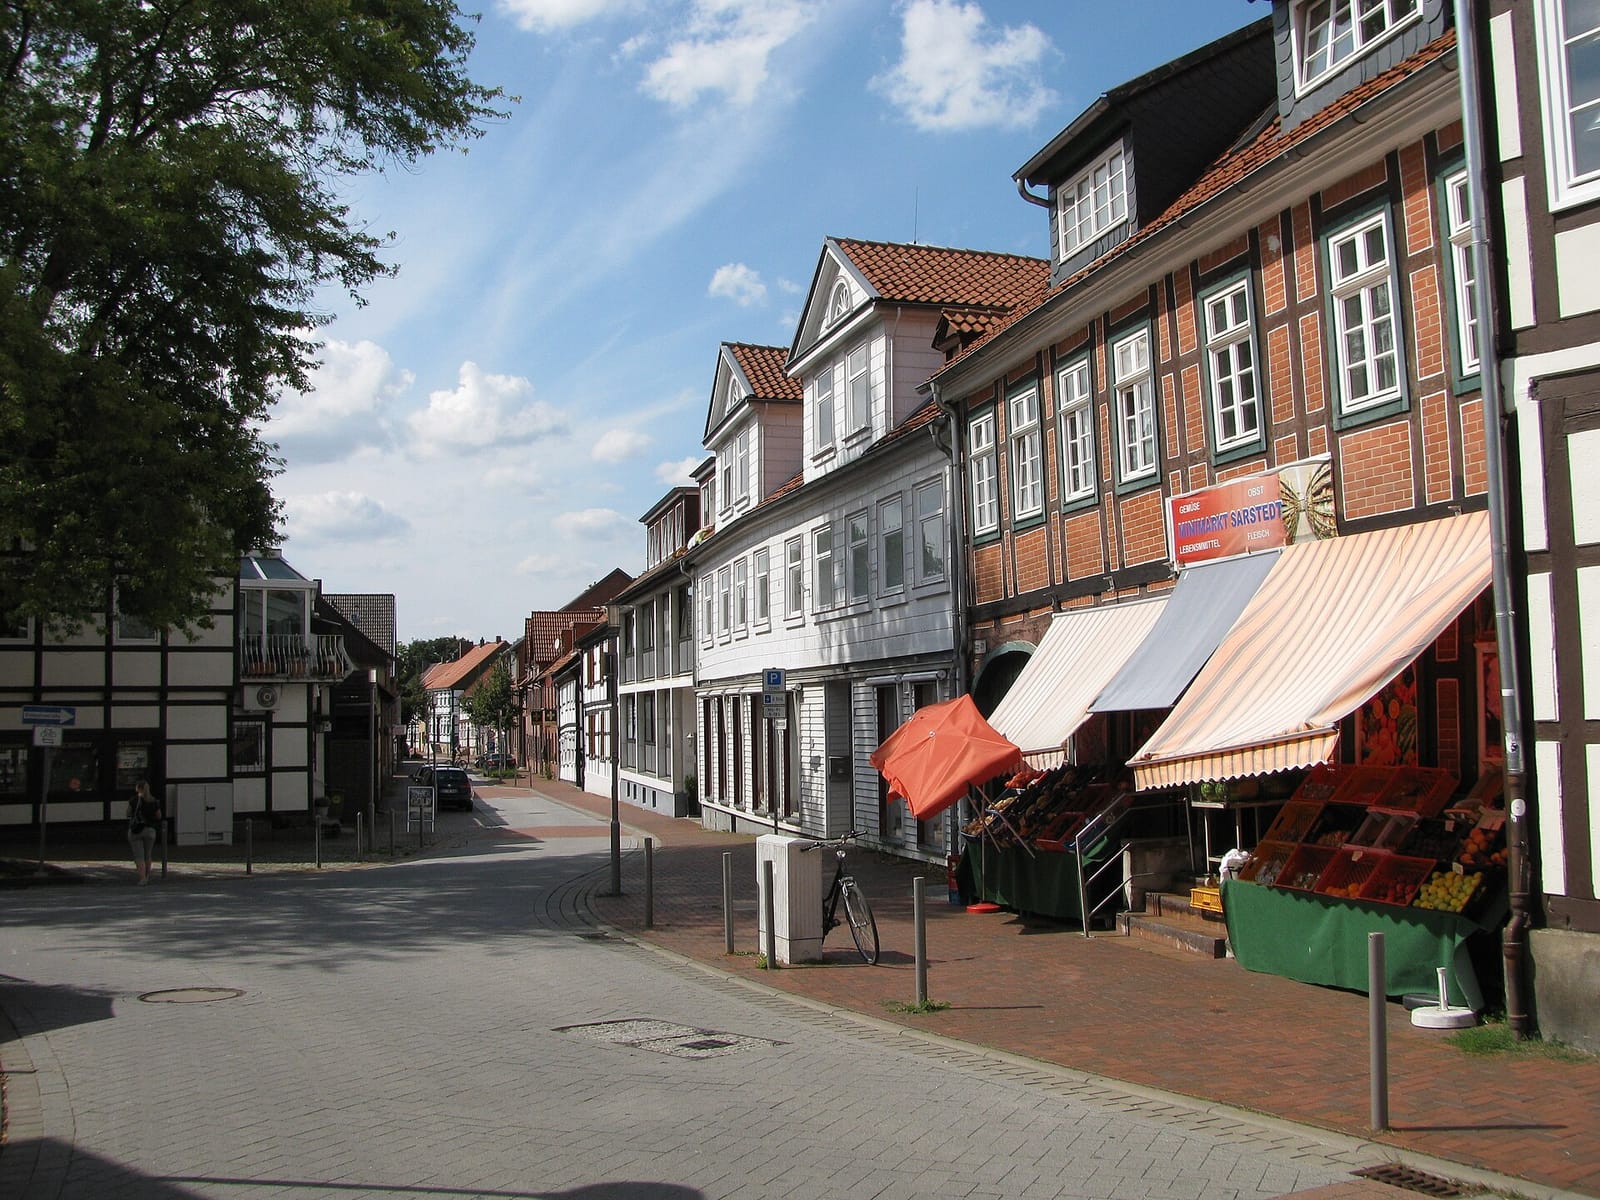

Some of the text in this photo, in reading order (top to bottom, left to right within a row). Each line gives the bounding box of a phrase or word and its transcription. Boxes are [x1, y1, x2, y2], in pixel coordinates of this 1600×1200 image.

[1248, 486, 1264, 497] OBST
[1231, 500, 1283, 528] SARSTEDT
[1247, 528, 1270, 541] FLEISCH
